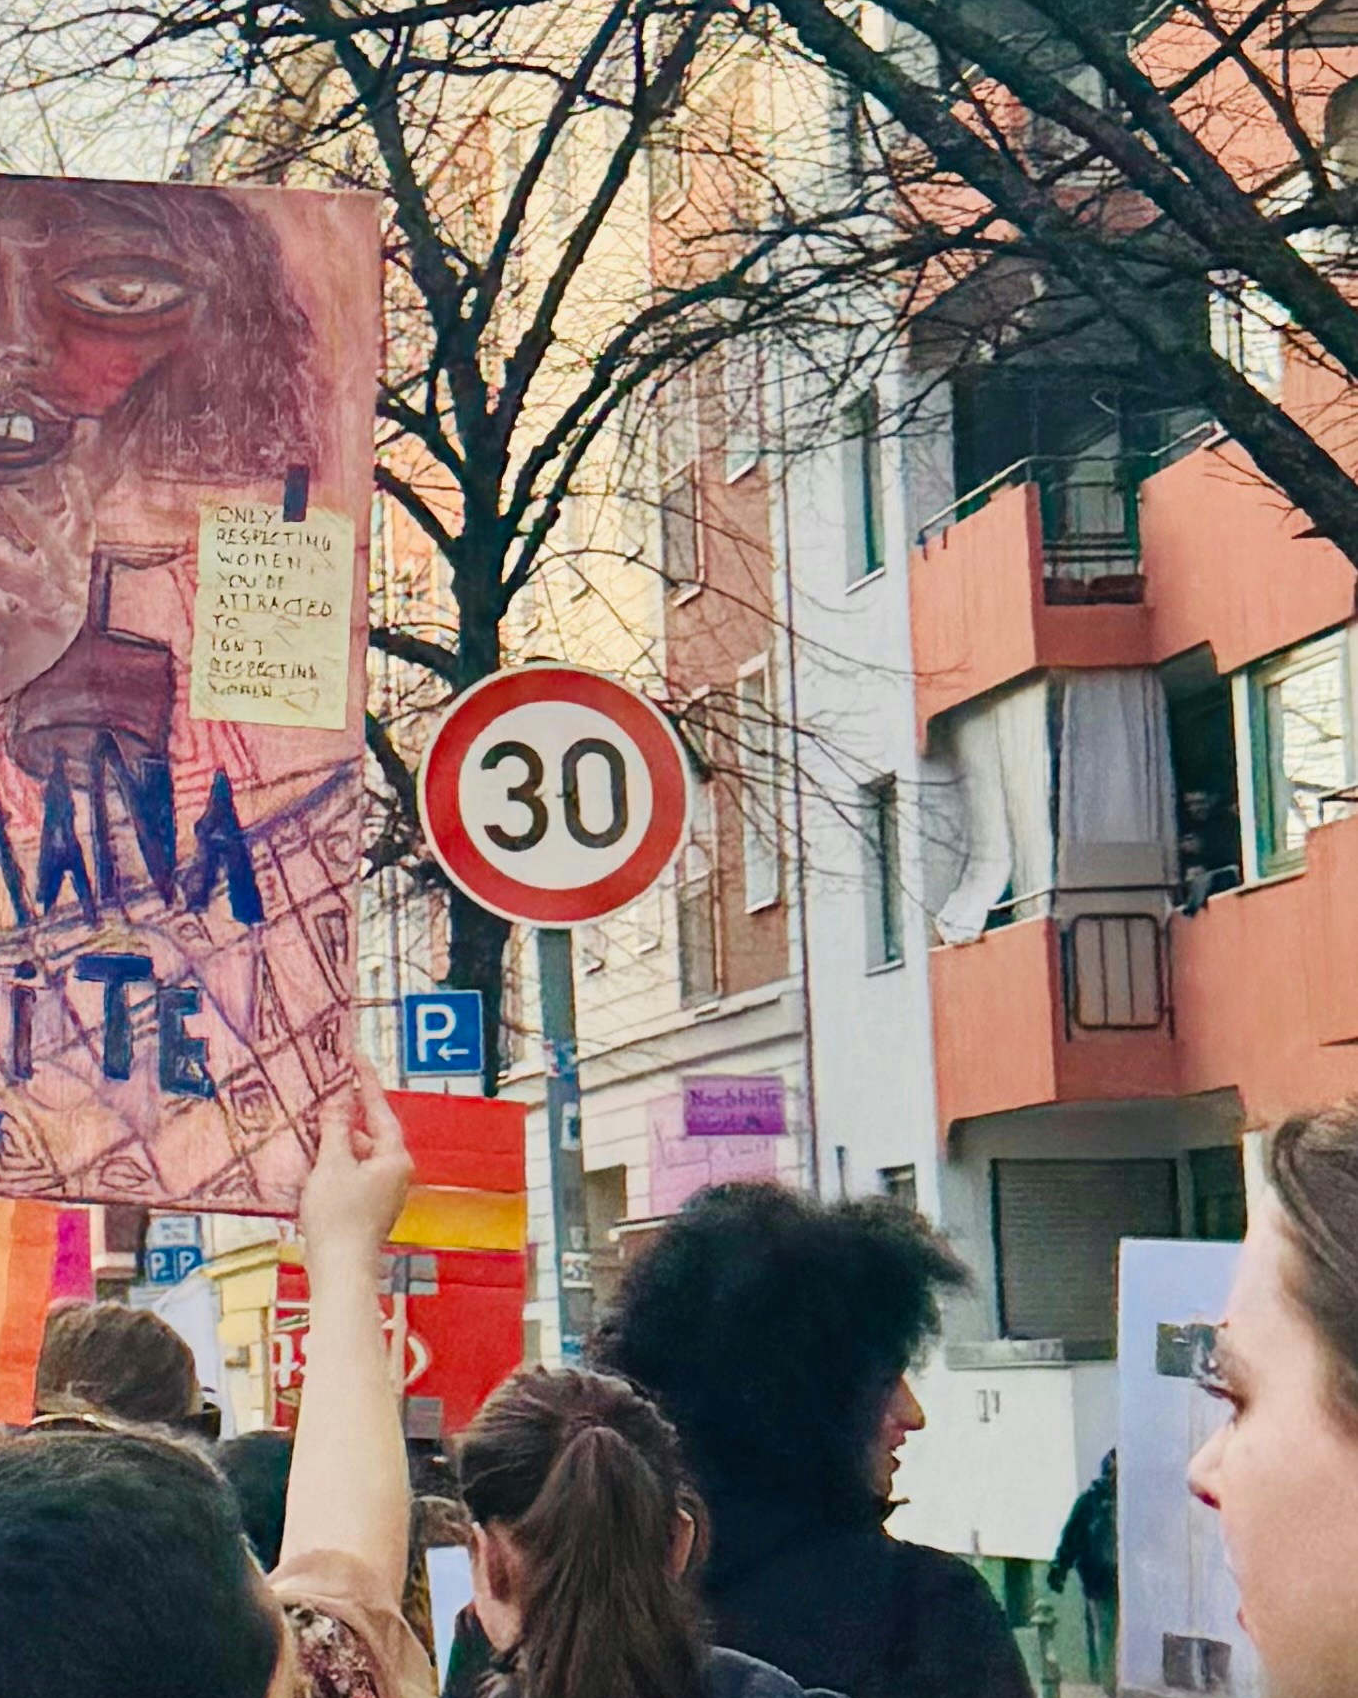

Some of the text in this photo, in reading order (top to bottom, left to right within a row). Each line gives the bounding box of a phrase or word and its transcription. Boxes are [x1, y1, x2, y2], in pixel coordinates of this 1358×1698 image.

[216, 505, 277, 527] ONLY
[216, 527, 331, 552] RESPECTING
[215, 592, 332, 618] ATTRACTED
[212, 614, 241, 630] TO
[481, 738, 629, 852] 30
[416, 1003, 456, 1063] P
